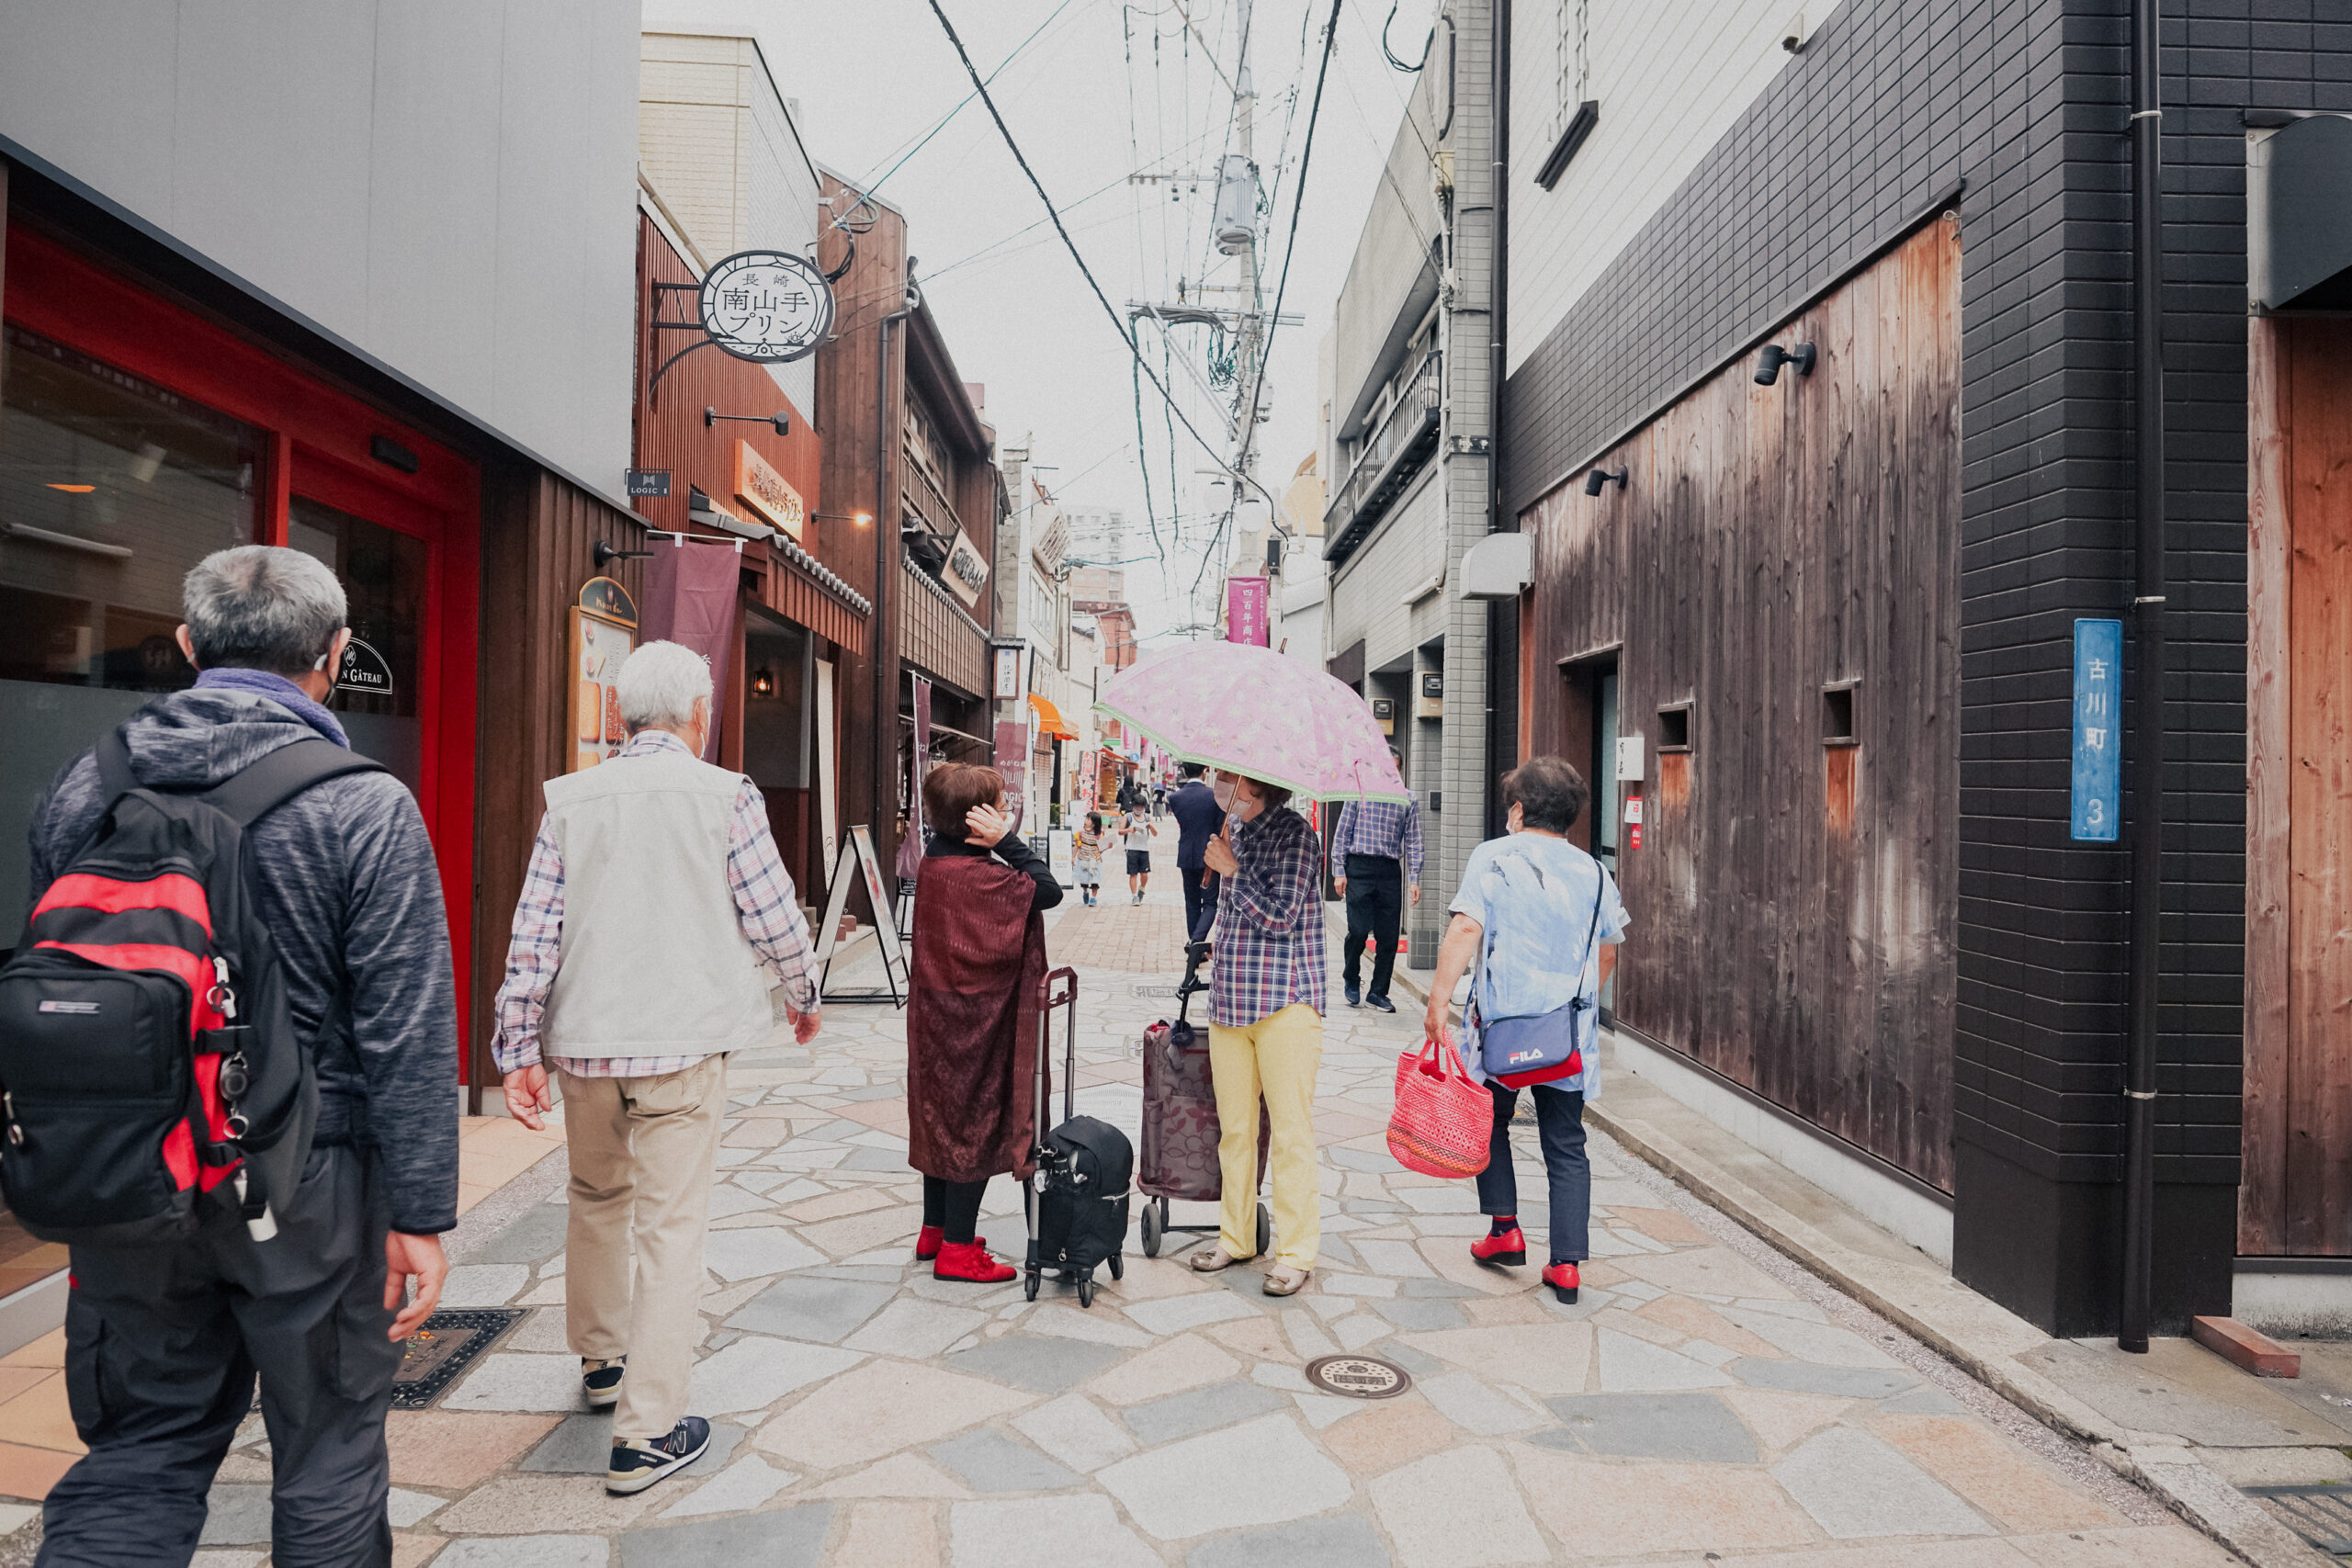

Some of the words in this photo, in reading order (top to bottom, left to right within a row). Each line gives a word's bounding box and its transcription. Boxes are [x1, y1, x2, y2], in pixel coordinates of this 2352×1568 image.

[742, 273, 789, 288] 長崎
[722, 288, 809, 312] 南山手
[729, 312, 803, 335] プリン
[350, 669, 382, 683] GÂTEAU
[2086, 658, 2109, 750] 古川町
[2086, 798, 2103, 824] 3
[1509, 1048, 1544, 1065] FILA
